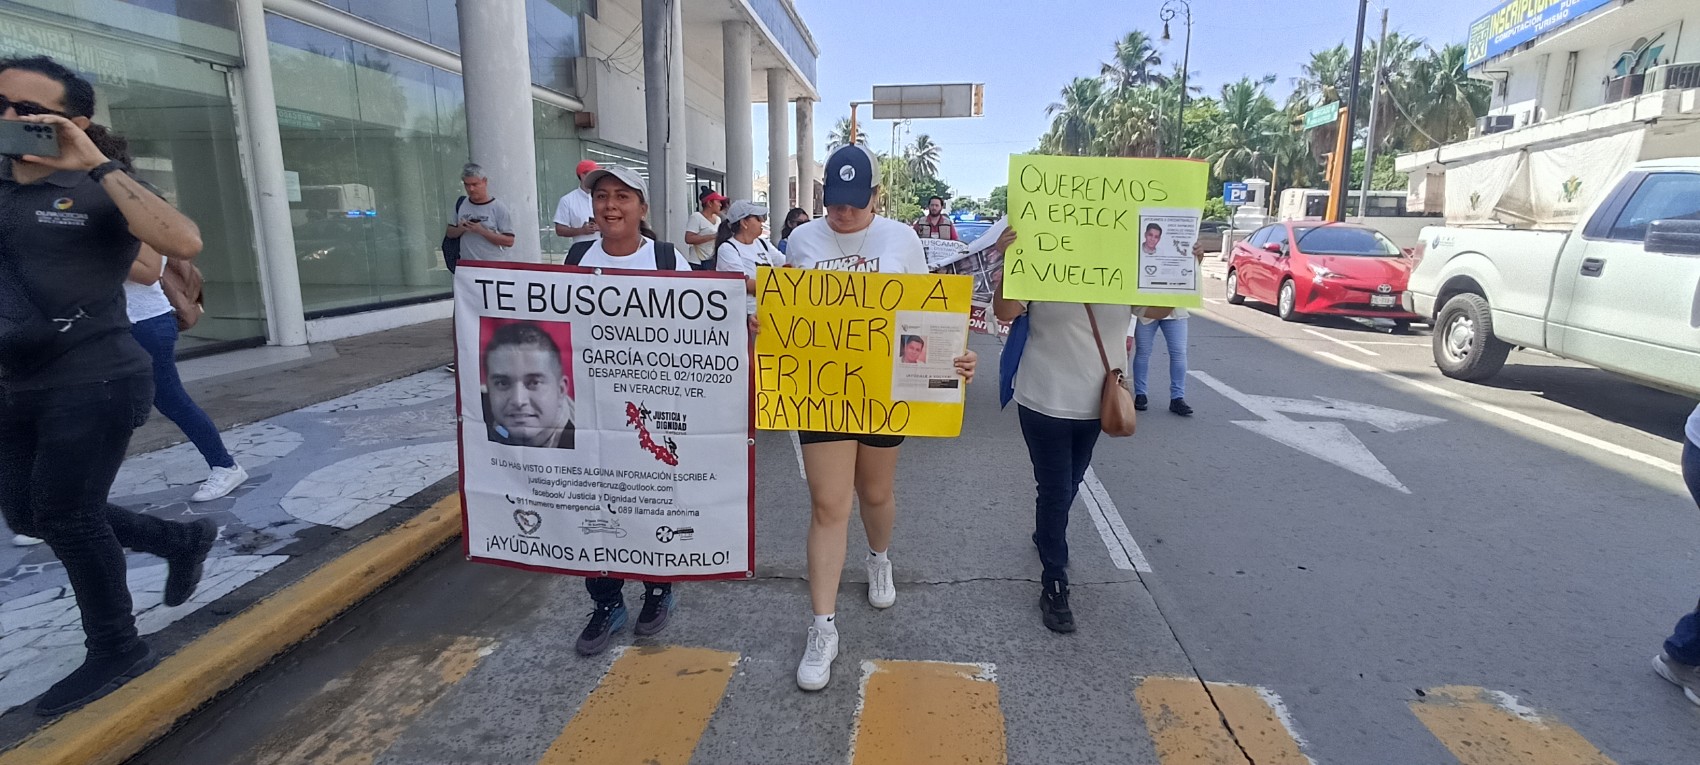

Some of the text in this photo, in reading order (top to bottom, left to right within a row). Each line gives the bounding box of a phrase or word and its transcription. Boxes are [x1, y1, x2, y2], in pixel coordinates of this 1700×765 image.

[1535, 9, 1569, 32] TURISMO
[1020, 163, 1168, 202] QUEREMOS
[1020, 201, 1129, 231] A ERICK
[1034, 232, 1074, 251] DE
[1031, 262, 1124, 290] VUELTA
[475, 279, 729, 322] TE BUSCAMOS
[761, 268, 948, 312] AYUDALO A
[590, 324, 730, 347] OSVALDO JULIÁN
[769, 313, 891, 357] VOLVER
[582, 347, 739, 372] GARCÍA COLORADO
[588, 366, 733, 384] DESAPARECIÓ EL 02/10/2020
[757, 354, 866, 397] ERICK
[613, 383, 706, 399] EN VERACRUZ, VER.
[653, 411, 680, 422] JUSTICIA
[756, 391, 910, 434] RAYMUNDO
[656, 421, 687, 431] DIGNIDAD
[490, 457, 499, 466] SI
[499, 459, 508, 468] LO
[508, 461, 522, 471] HAS
[522, 463, 545, 474] VISTO
[545, 465, 553, 474] O
[554, 465, 583, 475] TIENES
[583, 467, 615, 478] ALGUNA
[615, 469, 671, 481] INFORMACIÓN
[673, 472, 708, 482] ESCRIBE
[555, 502, 601, 512] emergencia
[567, 491, 596, 501] Justicia
[598, 494, 603, 502] y
[603, 493, 637, 504] Dignidad
[638, 495, 673, 505] Veracruz
[617, 505, 700, 517] 089 llamada anónima
[485, 534, 730, 569] ¡AYÚDANOS A ENCONTRARLO!
